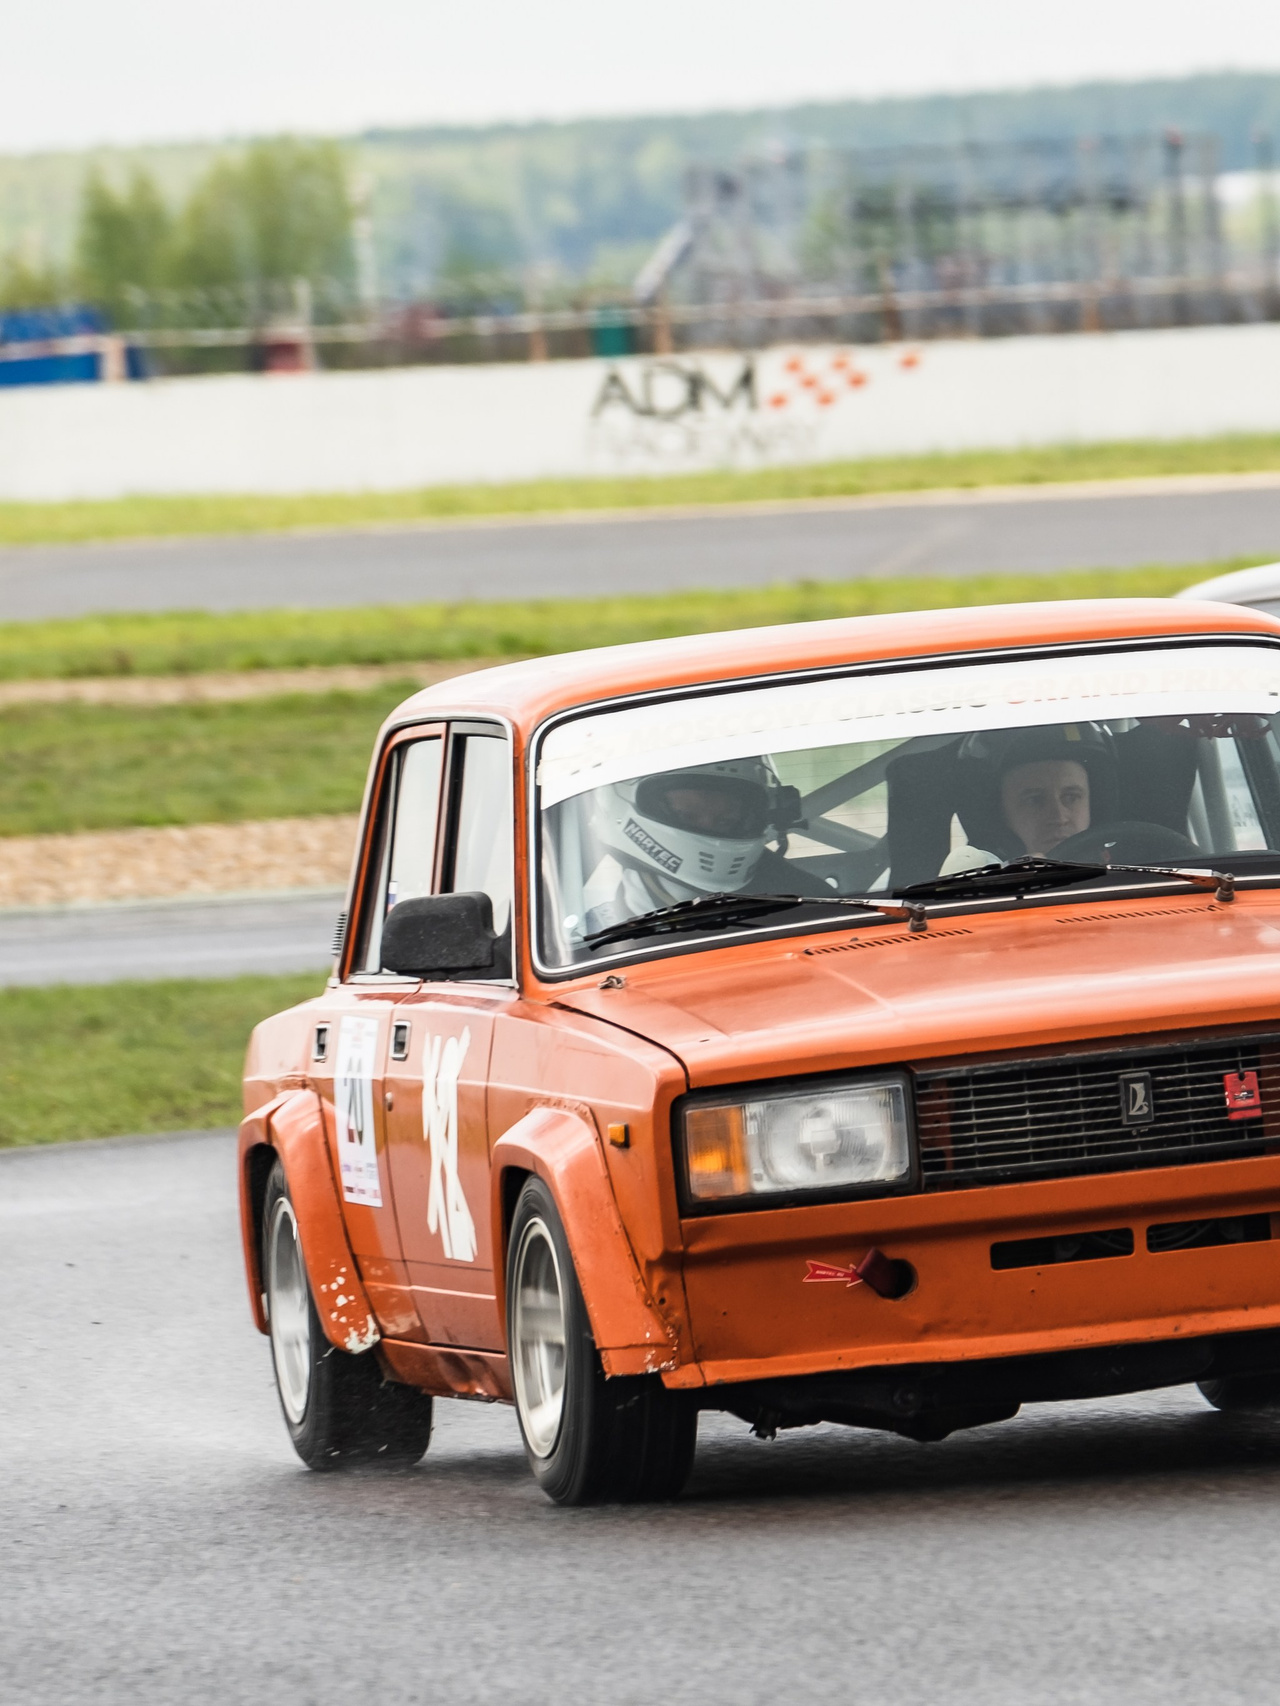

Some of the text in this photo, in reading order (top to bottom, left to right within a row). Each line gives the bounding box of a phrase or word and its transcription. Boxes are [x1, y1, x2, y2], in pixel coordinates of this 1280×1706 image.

[589, 353, 758, 420] ADM
[627, 668, 1250, 754] MOSCOW CLASSIC GRAND PRIX
